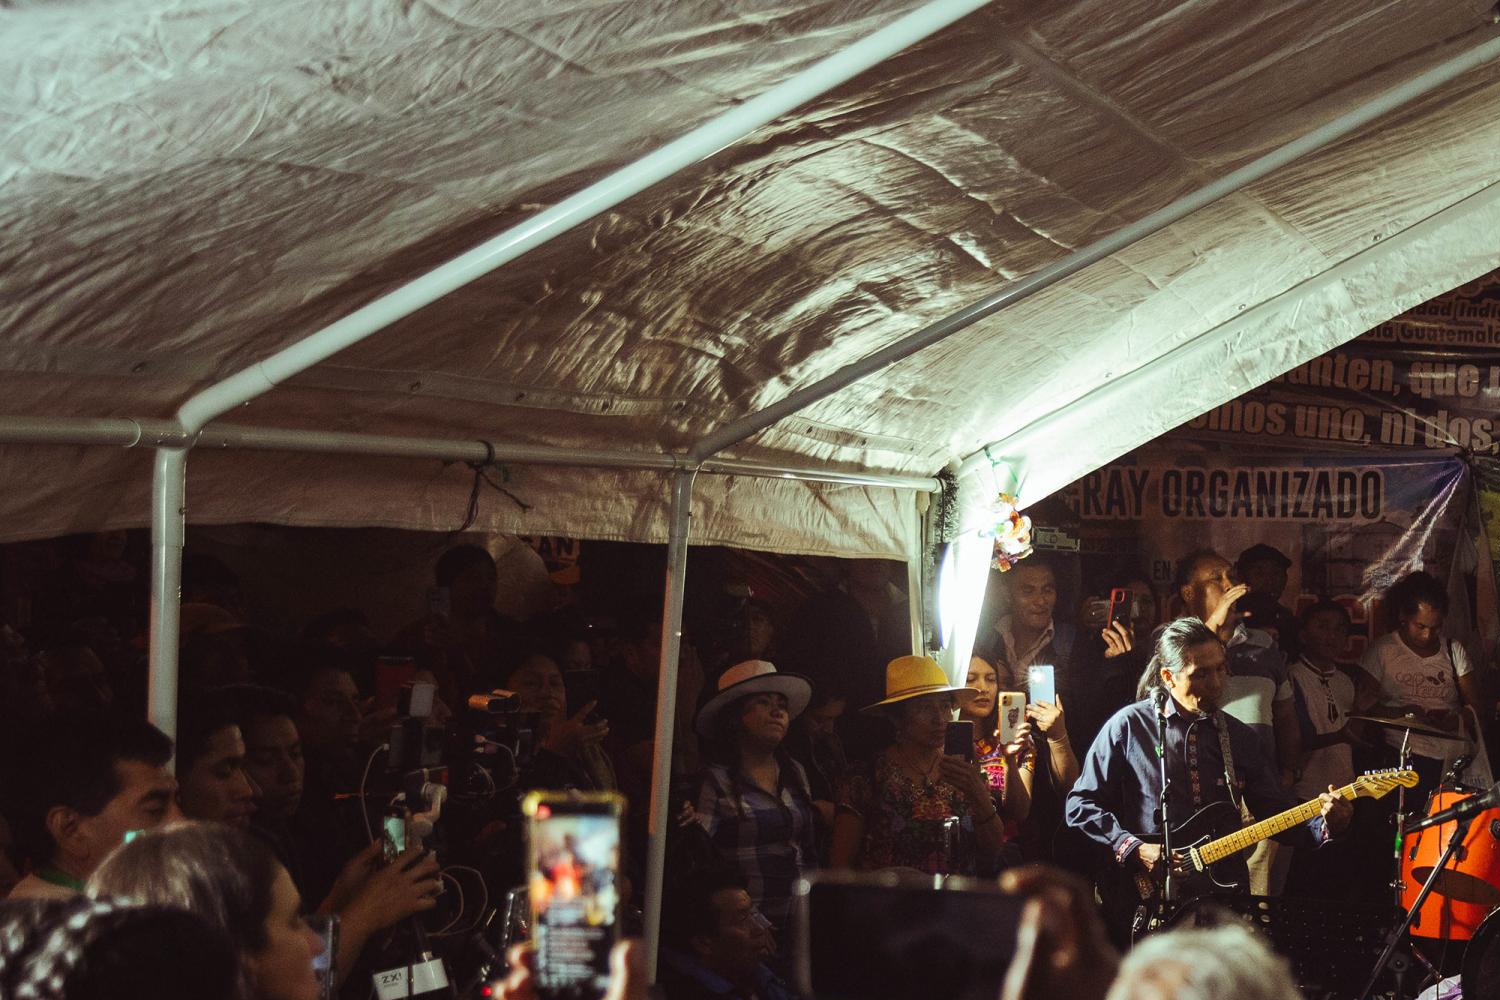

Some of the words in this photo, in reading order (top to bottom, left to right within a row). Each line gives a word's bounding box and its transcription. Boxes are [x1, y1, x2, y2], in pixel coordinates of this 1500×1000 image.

[1272, 351, 1400, 396] anten,
[1408, 358, 1480, 399] que
[1294, 404, 1372, 446] uno,
[1380, 407, 1417, 446] ni
[1423, 409, 1499, 455] dos,
[1161, 468, 1382, 520] ORGANIZADO
[1152, 559, 1171, 581] EN
